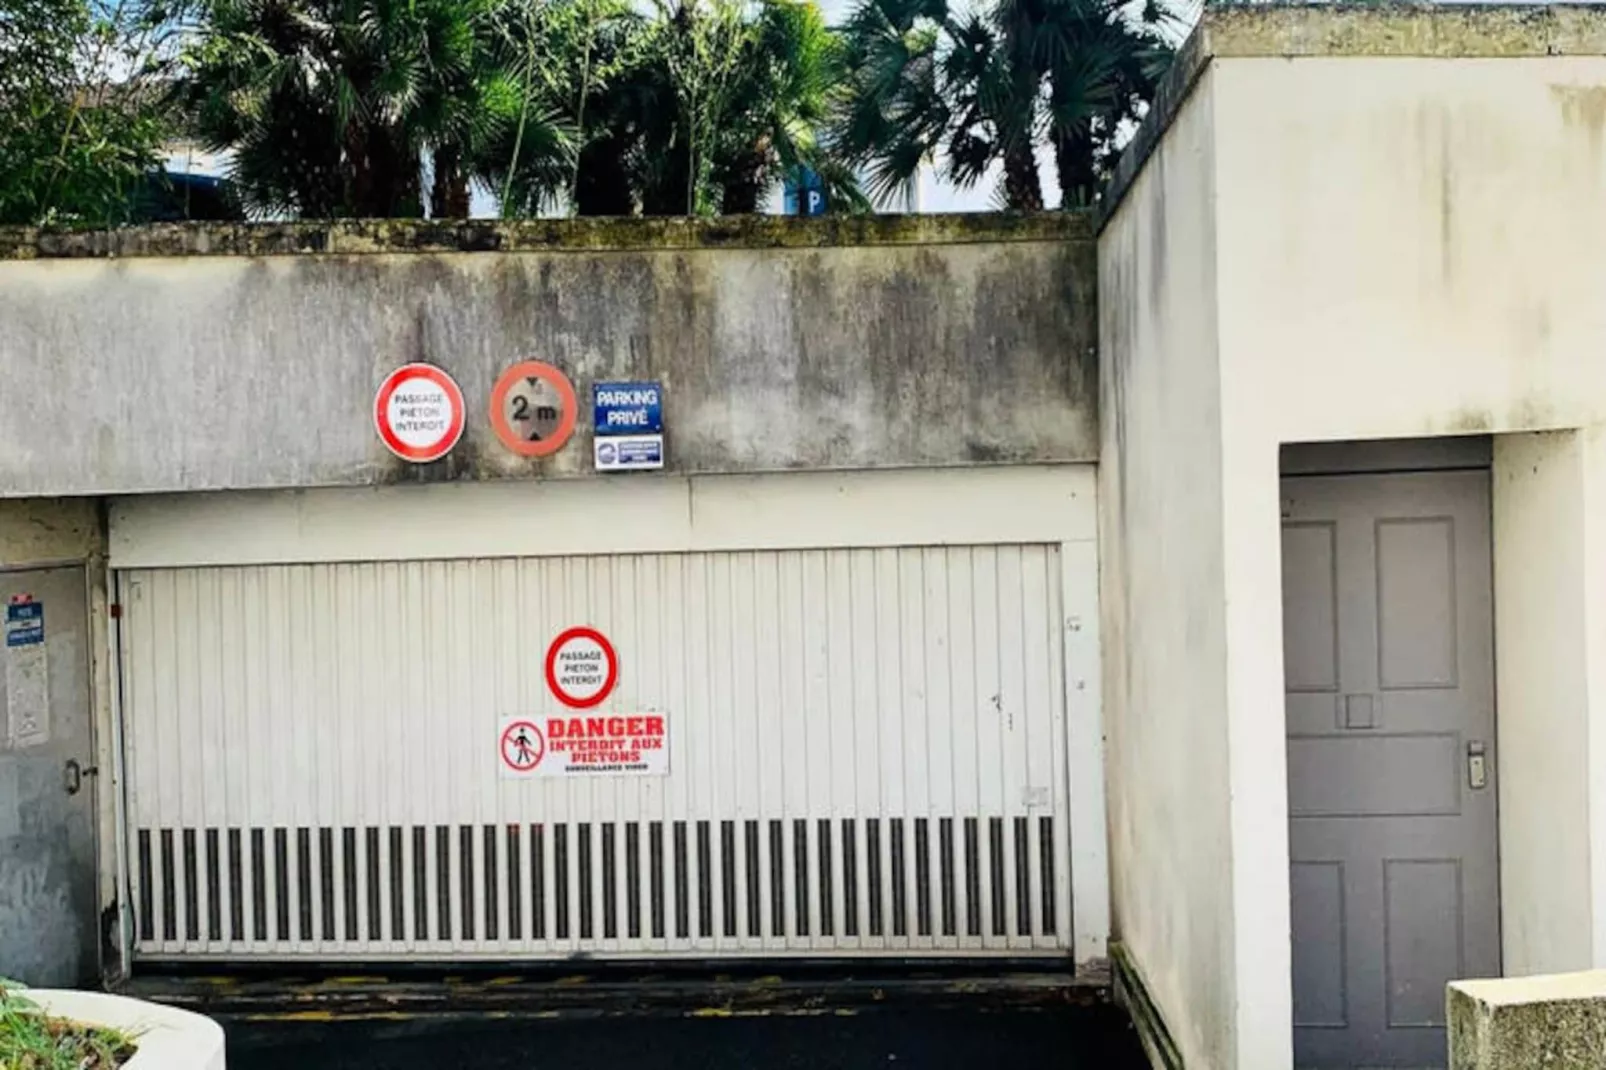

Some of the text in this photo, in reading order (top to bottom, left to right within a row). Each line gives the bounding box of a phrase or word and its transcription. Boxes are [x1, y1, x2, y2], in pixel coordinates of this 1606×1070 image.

[394, 394, 443, 405] PASSAGE
[596, 390, 658, 406] PARKING
[512, 395, 557, 420] 2 m
[607, 408, 648, 426] PRIVÉ
[395, 420, 445, 432] INTERDIT
[559, 652, 602, 661] PASSAGE
[564, 664, 599, 672] PIETON
[560, 676, 602, 685] INTERDIT
[547, 716, 664, 738] DANGER
[549, 738, 663, 751] INTERDIT AUX
[571, 751, 641, 763] PIETONS
